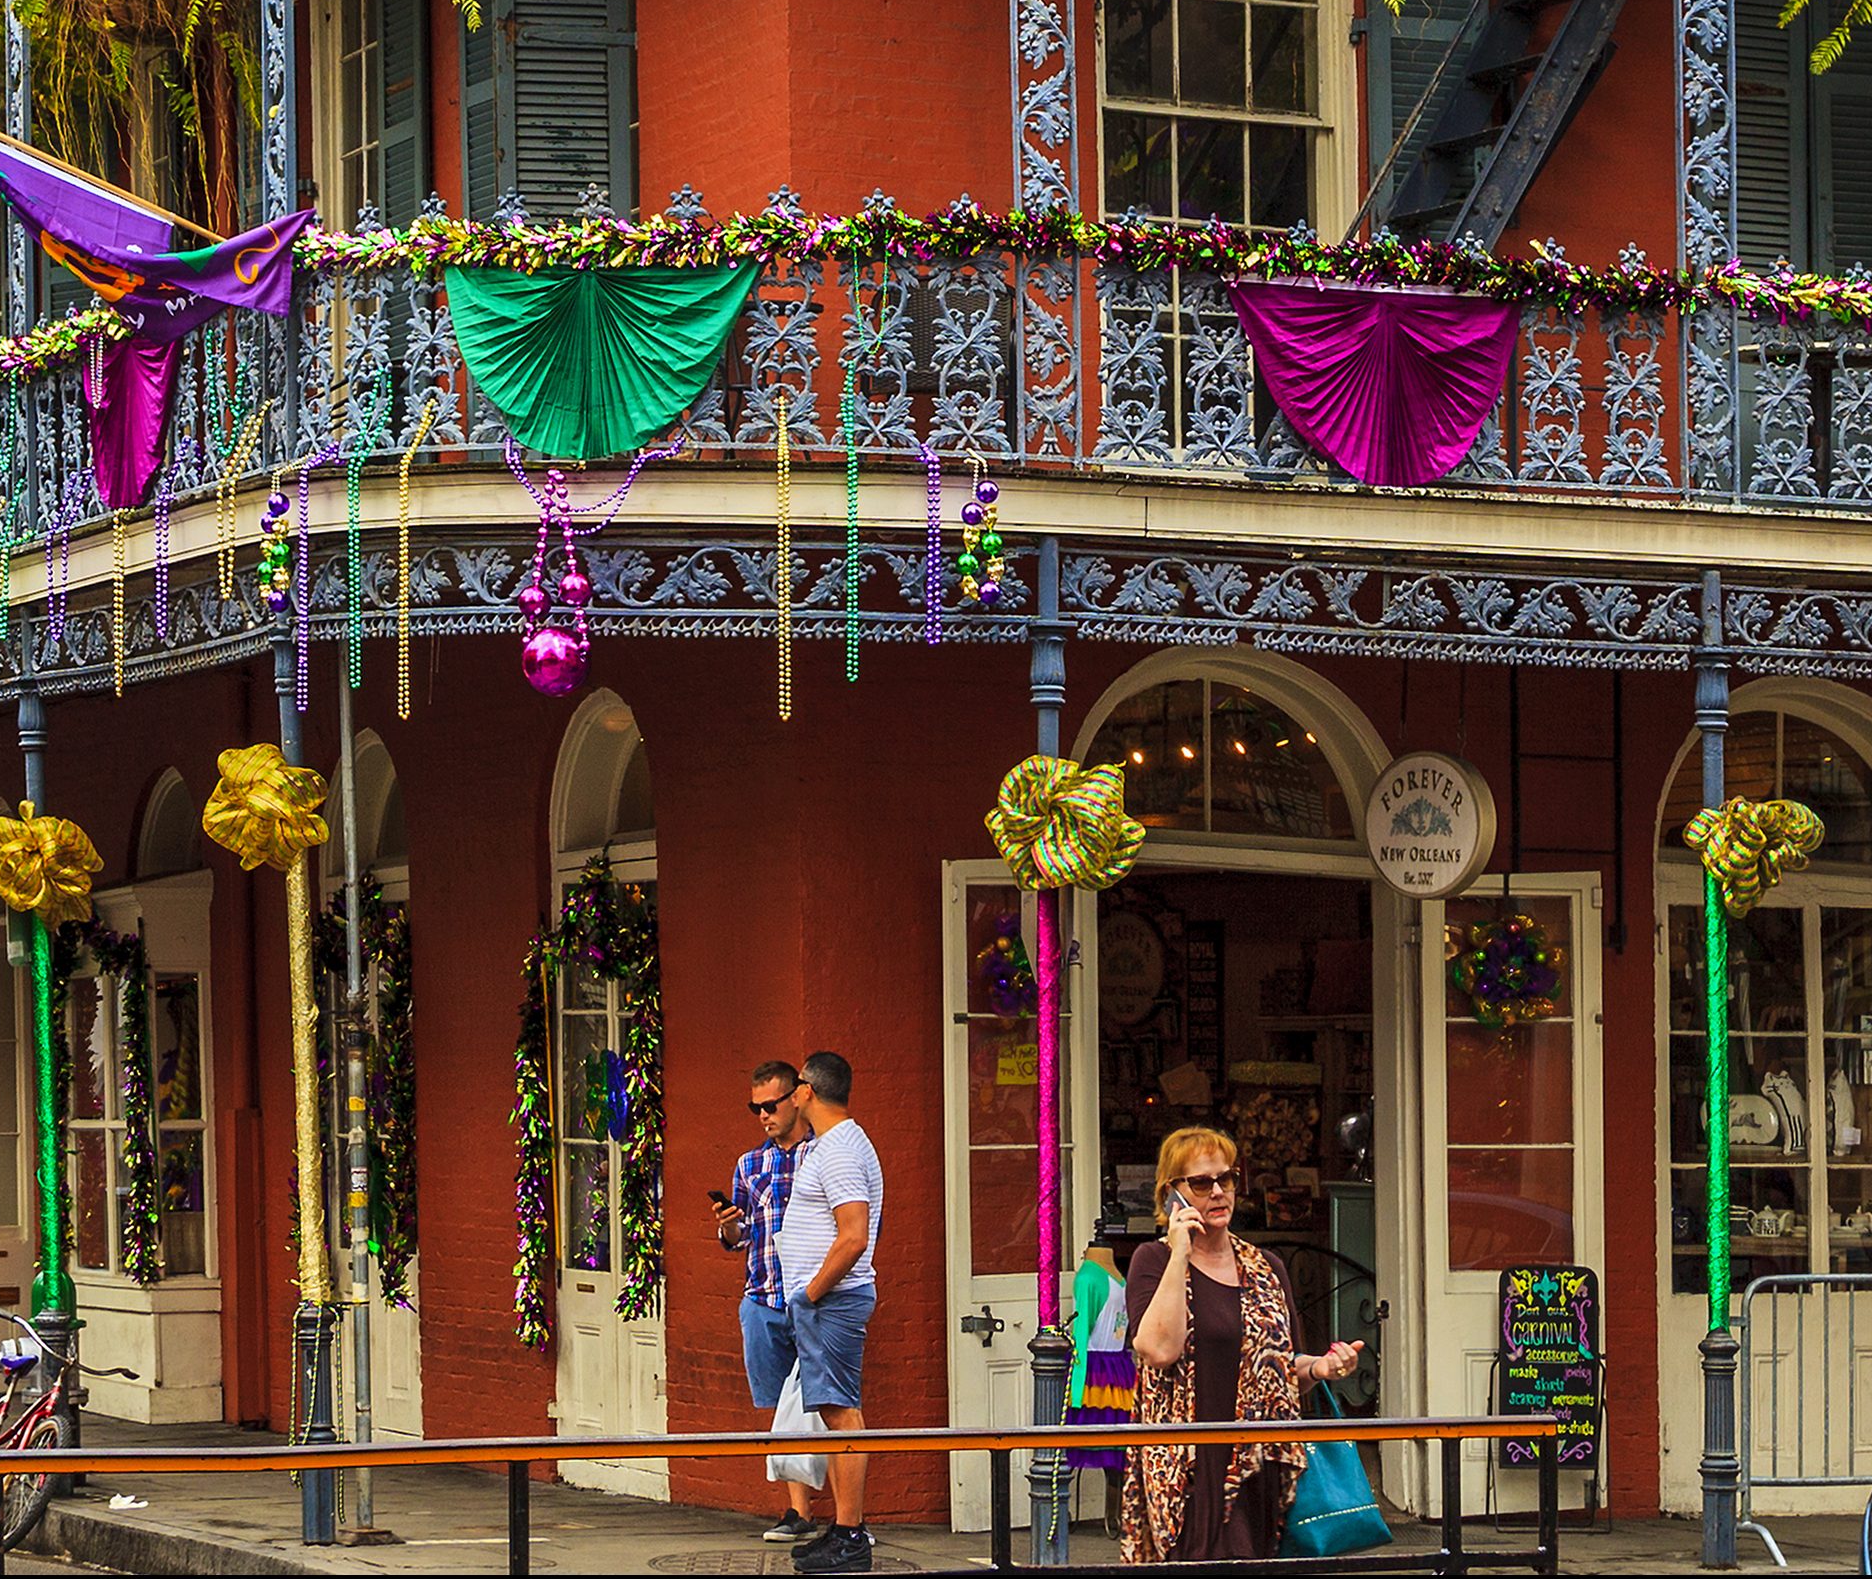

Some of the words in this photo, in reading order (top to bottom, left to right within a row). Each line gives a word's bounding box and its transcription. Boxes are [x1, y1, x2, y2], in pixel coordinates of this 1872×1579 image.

[1380, 768, 1464, 817] FOREVER
[1515, 1303, 1540, 1317] Don
[1509, 1364, 1539, 1379] masks
